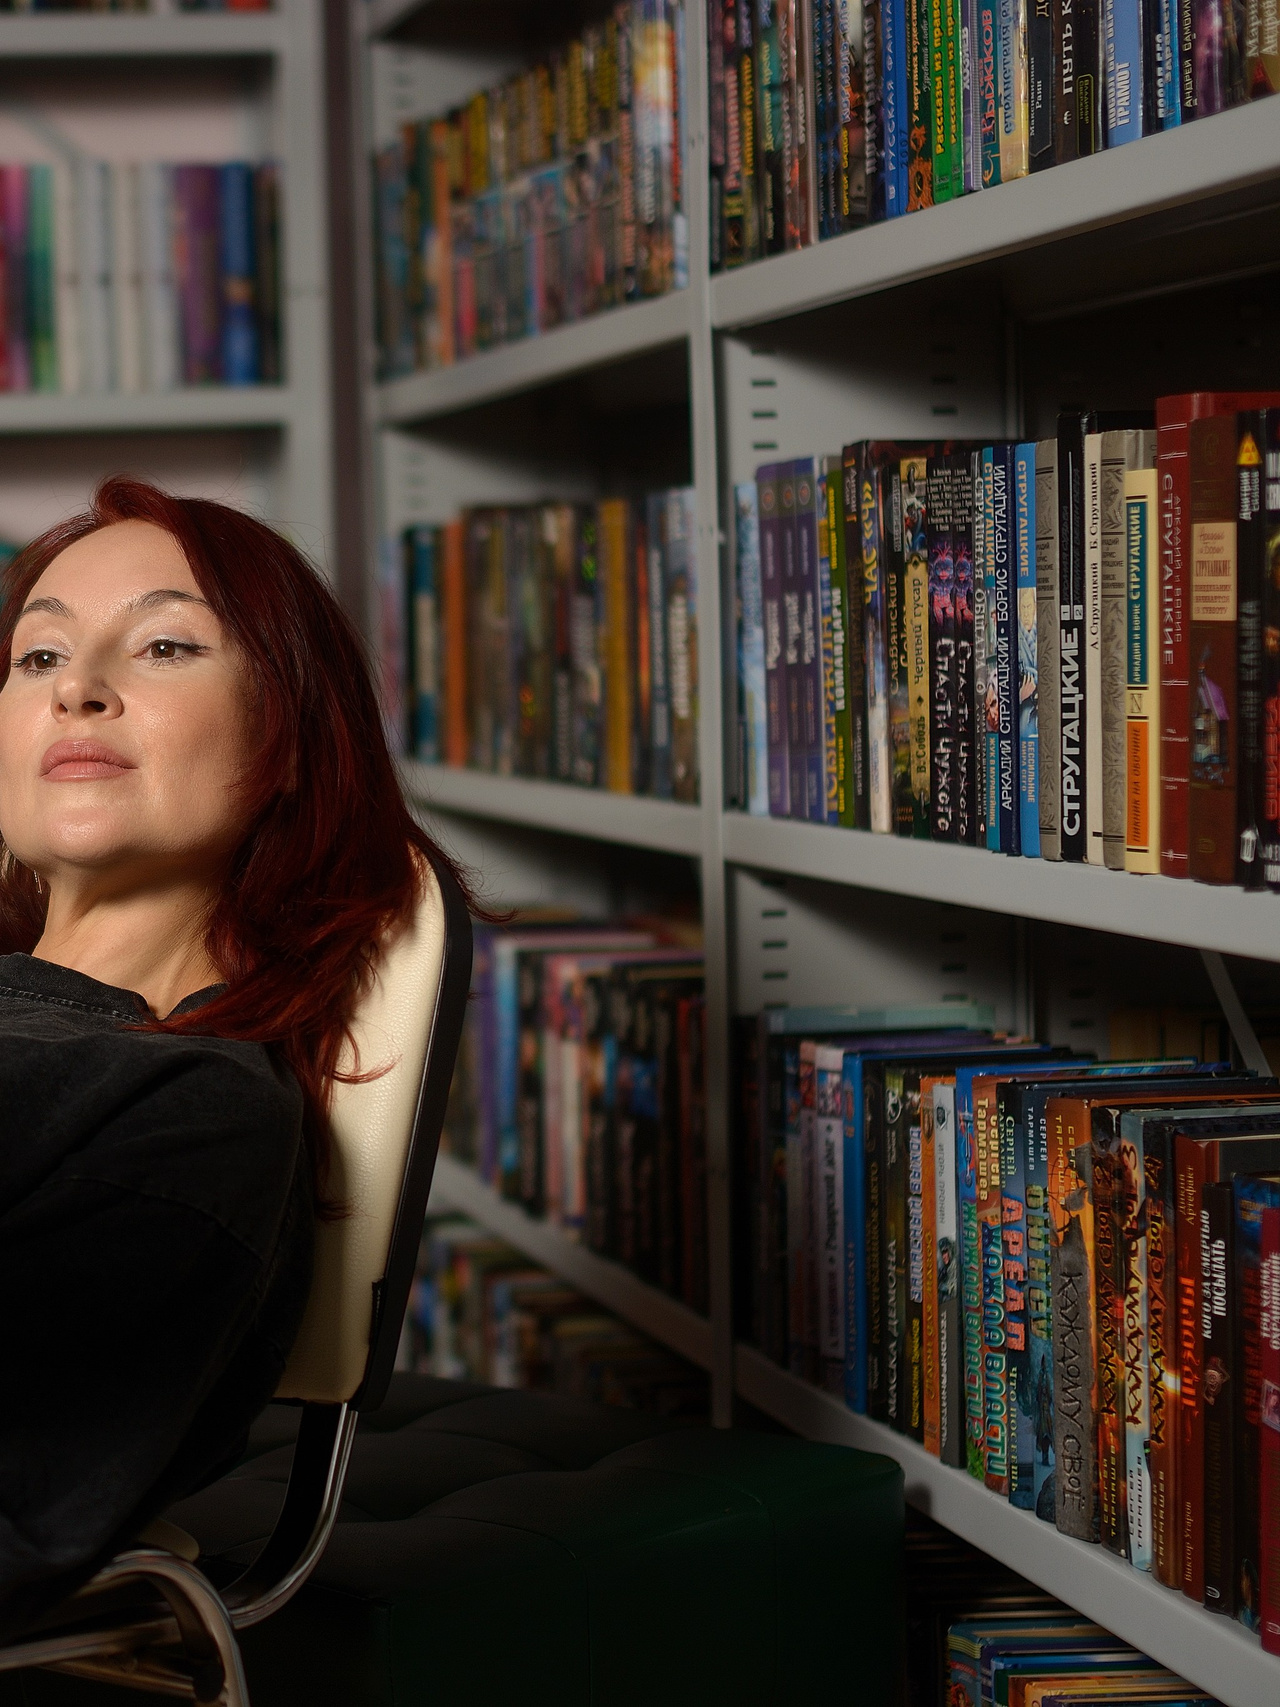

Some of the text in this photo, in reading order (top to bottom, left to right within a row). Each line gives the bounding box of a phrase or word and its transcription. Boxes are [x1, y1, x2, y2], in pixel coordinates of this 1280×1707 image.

[933, 51, 943, 73] из
[947, 40, 958, 145] Рассказы из
[1028, 56, 1036, 138] Максимилиан
[1061, 23, 1074, 96] ПУТЬ
[1116, 61, 1132, 127] ГРАМОТ
[1183, 58, 1198, 109] АНДРЕЙ
[886, 80, 896, 171] РУССКАЯ
[900, 129, 909, 169] 2007
[933, 75, 946, 155] Рассказы
[974, 477, 985, 580] СТРАШНАЯ
[984, 462, 996, 577] СТРУГАЦКИЕ
[1017, 460, 1030, 578] СТРУГАЦКИЕ
[1089, 462, 1099, 536] Стругацкий
[862, 548, 878, 605] ЧАС
[1089, 538, 1099, 550] Б.
[1130, 505, 1141, 601] СТРУГАЦКИЕ
[1162, 472, 1174, 665] СТРУГАЦКИЕ
[887, 572, 899, 696] Славянский
[912, 577, 925, 685] Черный гусар
[994, 464, 1012, 811] АРКАДИЙ СТРУГАЦКИЙ БОРИС СТРУГАЦКИЙ
[1089, 562, 1099, 637] Стругацкий
[1131, 603, 1141, 632] БОРИС
[831, 586, 846, 712] КОМАНДАРМ
[1132, 642, 1142, 683] АРКАДИЙ
[915, 714, 926, 761] Соболь
[988, 737, 996, 754] ЖУК
[1027, 740, 1036, 804] БЕССИЛЬНЫЕ
[1061, 627, 1084, 837] СТРУГАЦКИЕ
[988, 764, 997, 828] МУРАВЕЙНИКЕ
[1131, 727, 1141, 843] ПИКНИК НА ОБОЧИНЕ
[977, 1098, 989, 1201] Тармашев
[1006, 1115, 1017, 1176] СЕРГЕЙ
[1027, 1106, 1035, 1171] ТАРМАШЕВ
[1039, 1117, 1048, 1162] СЕРГЕЙ
[1054, 1114, 1066, 1205] ТАРМАШЕВ
[1067, 1125, 1077, 1191] СЕРГЕЙ
[908, 1125, 923, 1304] ЗАПАСНЫЙ ВЫХОД
[1184, 1164, 1196, 1226] Артефакт
[1001, 1195, 1025, 1352] АРЕАЛ
[1123, 1145, 1144, 1426] КАЖДОМУ 3
[1199, 1209, 1213, 1340] КОГО ЗА СМЕРТЬЮ
[1211, 1238, 1228, 1317] ПОСЫЛАТЬ
[887, 1238, 899, 1420] МАСКА ДЕМОНА
[963, 1200, 984, 1441] ЖАЖДА ВЛАСТИ 2
[982, 1222, 1008, 1477] ЖАЖДА ВЛАСТИ
[1055, 1271, 1085, 1430] КАЖДОМУ
[1098, 1275, 1118, 1416] КАЖДОМУ
[1260, 1308, 1271, 1339] ТРИ
[1009, 1366, 1018, 1401] ЧТО
[1149, 1285, 1168, 1445] КАЖДОМУ
[1110, 1444, 1118, 1538] ТАРМАШЕВ
[1183, 1500, 1195, 1582] Виктор Угаров
